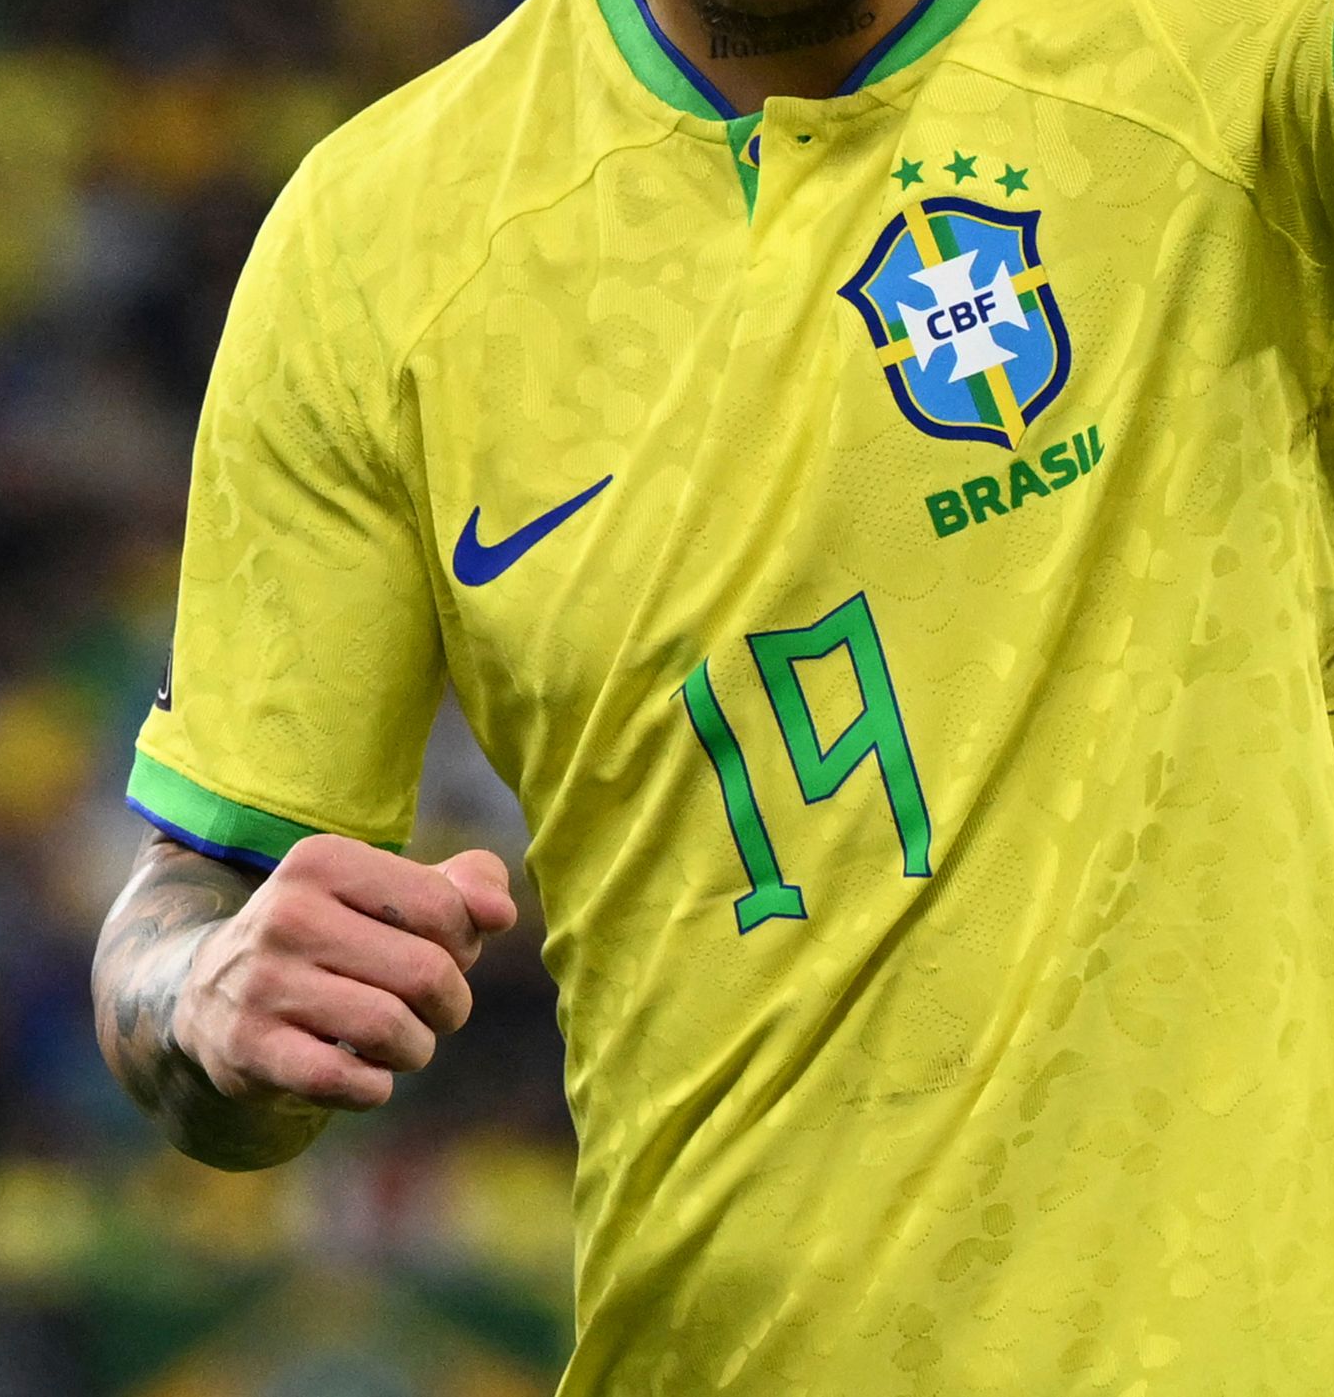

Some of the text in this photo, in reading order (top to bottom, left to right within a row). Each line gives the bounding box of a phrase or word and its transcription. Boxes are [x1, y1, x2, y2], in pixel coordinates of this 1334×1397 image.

[926, 290, 997, 341] CBF
[924, 424, 1106, 539] BRASIL
[668, 590, 933, 936] 19
